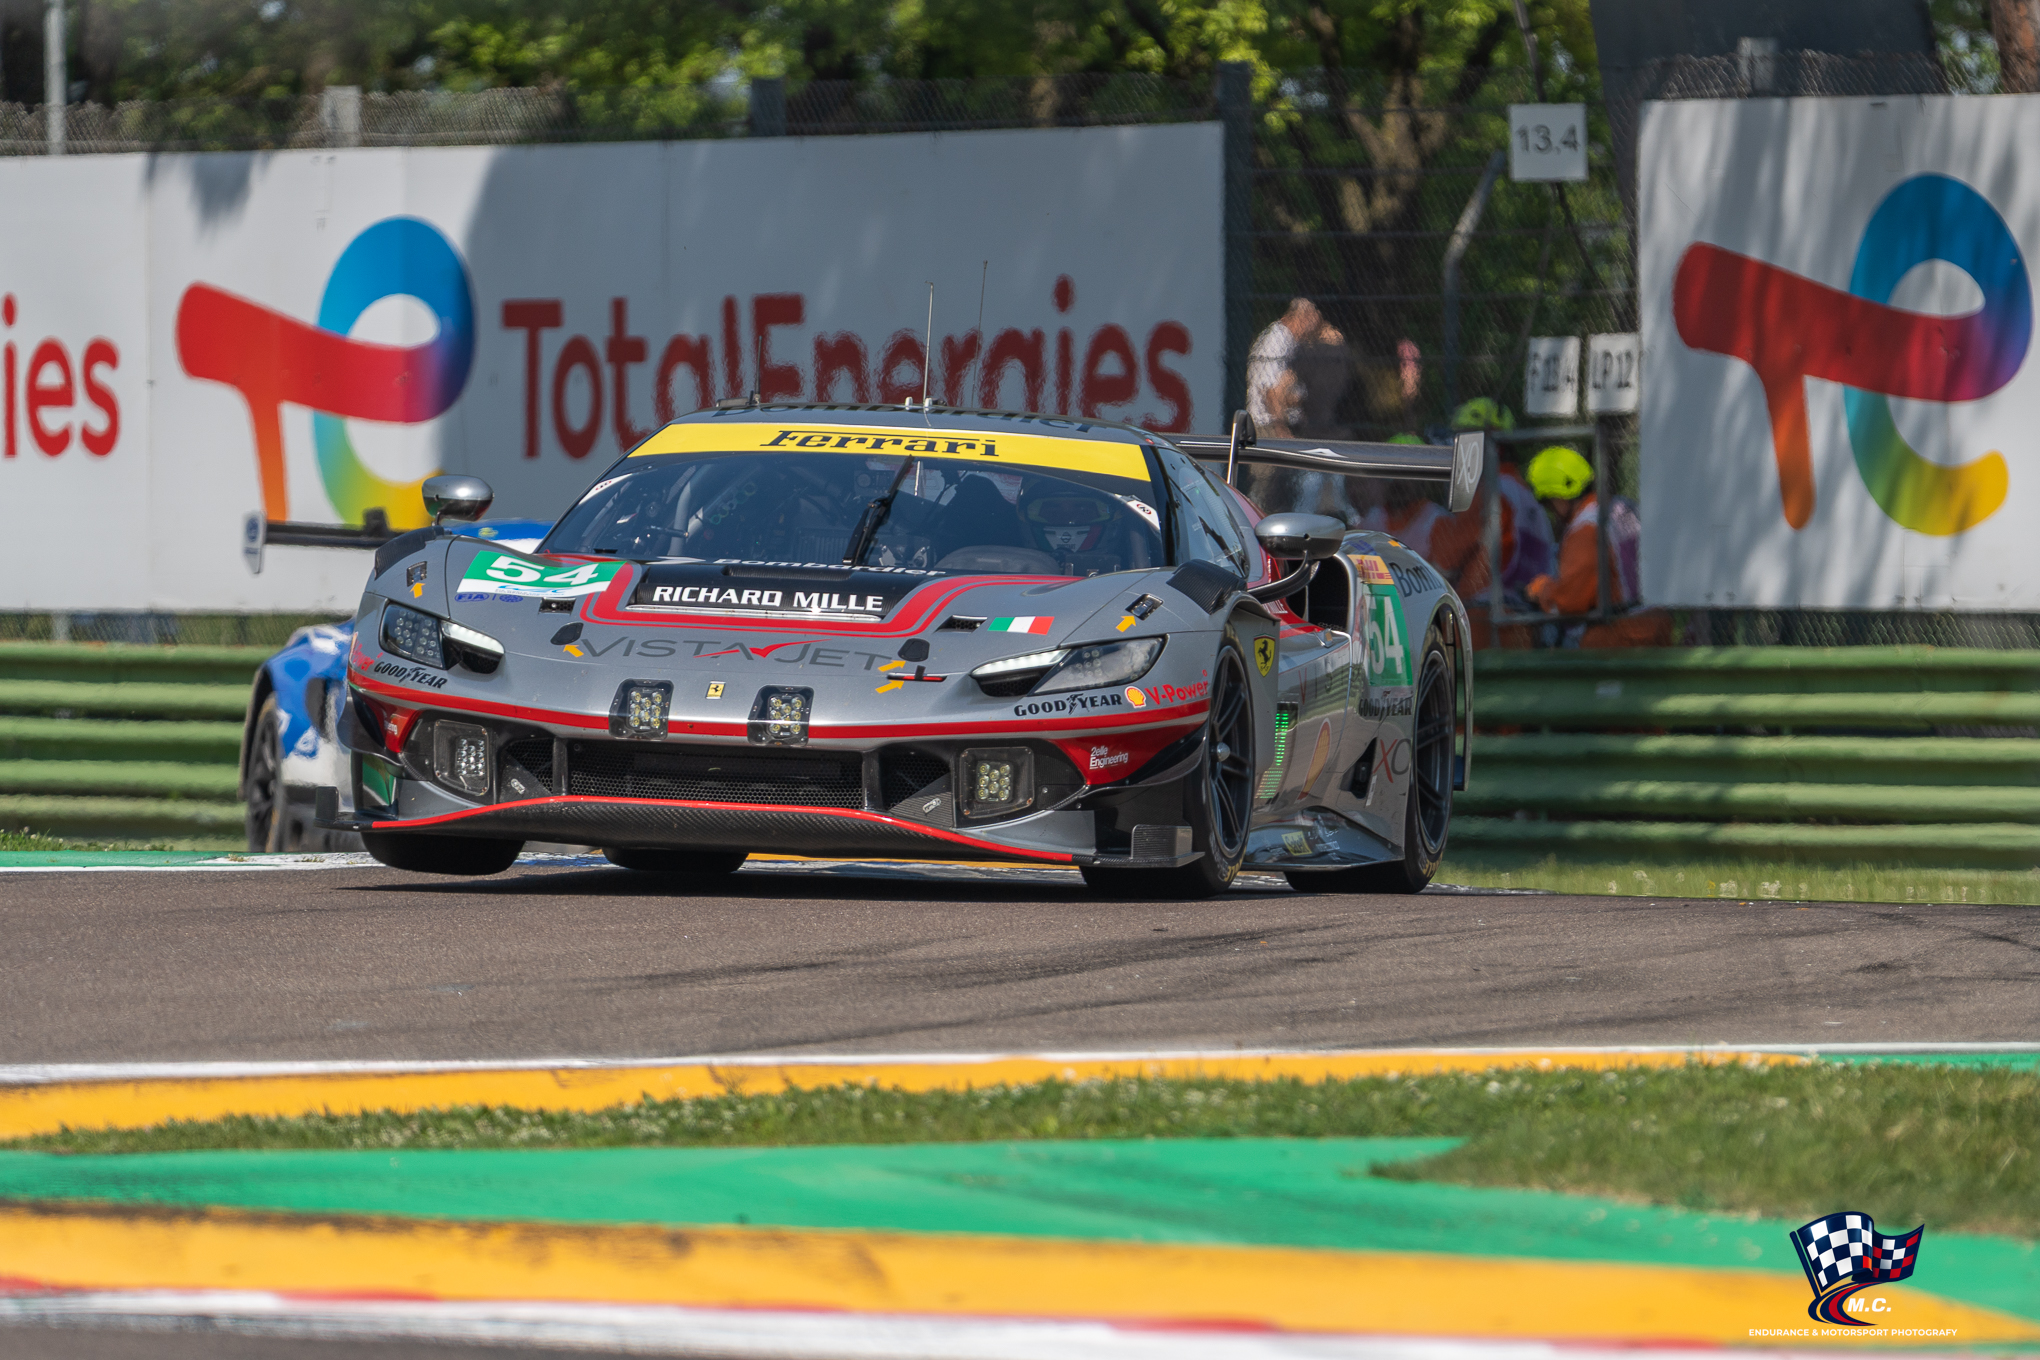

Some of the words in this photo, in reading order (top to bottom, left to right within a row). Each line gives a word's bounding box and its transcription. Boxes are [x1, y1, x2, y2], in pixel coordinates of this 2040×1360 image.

[760, 430, 999, 457] Ferrari
[486, 555, 599, 586] 54
[652, 586, 783, 607] RICHARD
[793, 591, 884, 611] MILLE
[1367, 596, 1404, 675] 54
[1145, 680, 1209, 705] V-Power
[1090, 751, 1129, 769] Engineering
